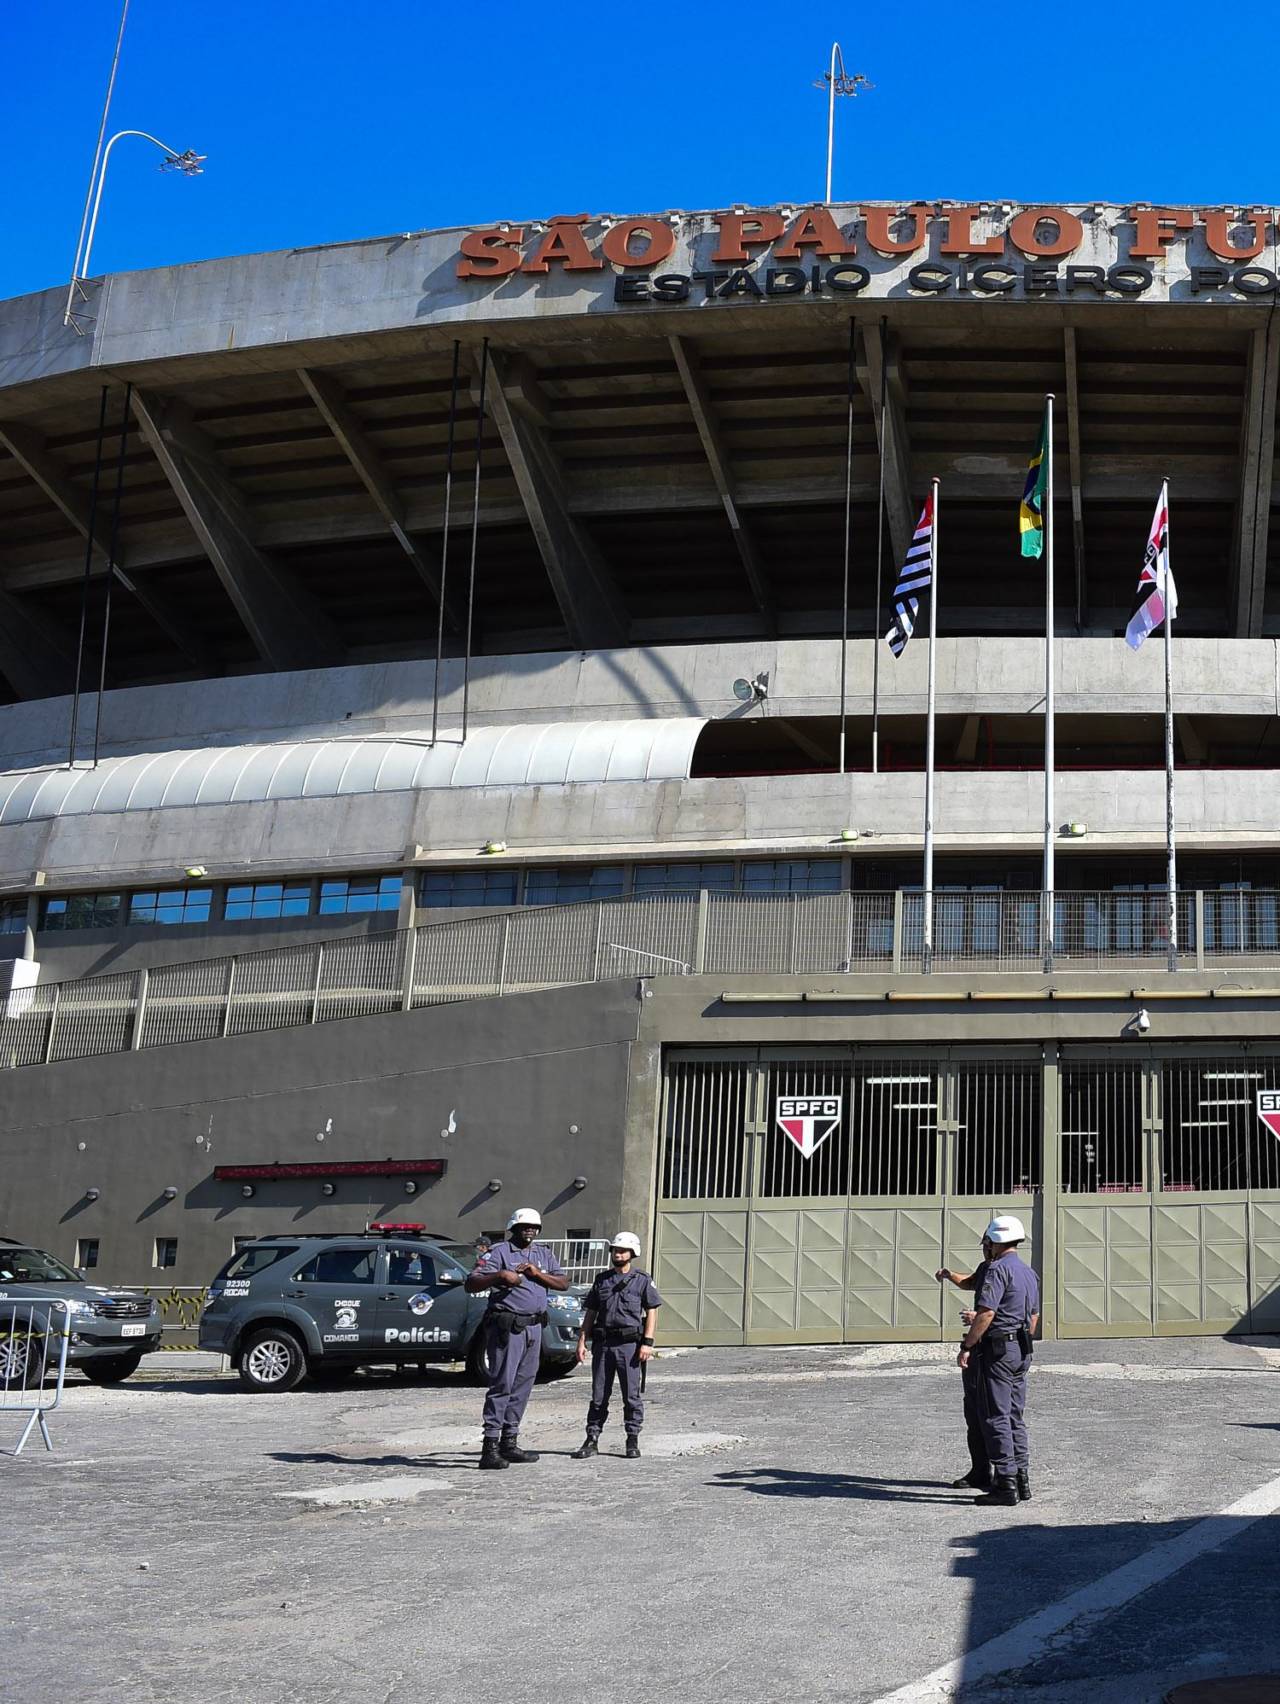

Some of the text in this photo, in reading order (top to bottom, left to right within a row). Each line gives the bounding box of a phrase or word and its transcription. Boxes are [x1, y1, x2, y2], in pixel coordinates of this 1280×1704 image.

[456, 212, 678, 279] SÃO
[711, 205, 1084, 262] PAULO
[613, 257, 871, 302] ESTÁDIO
[907, 255, 1153, 293] CÍCERO
[781, 1101, 837, 1116] SPFC
[223, 1288, 250, 1297] ROCAM
[323, 1334, 360, 1343] COMANDO
[384, 1327, 451, 1343] Polícia
